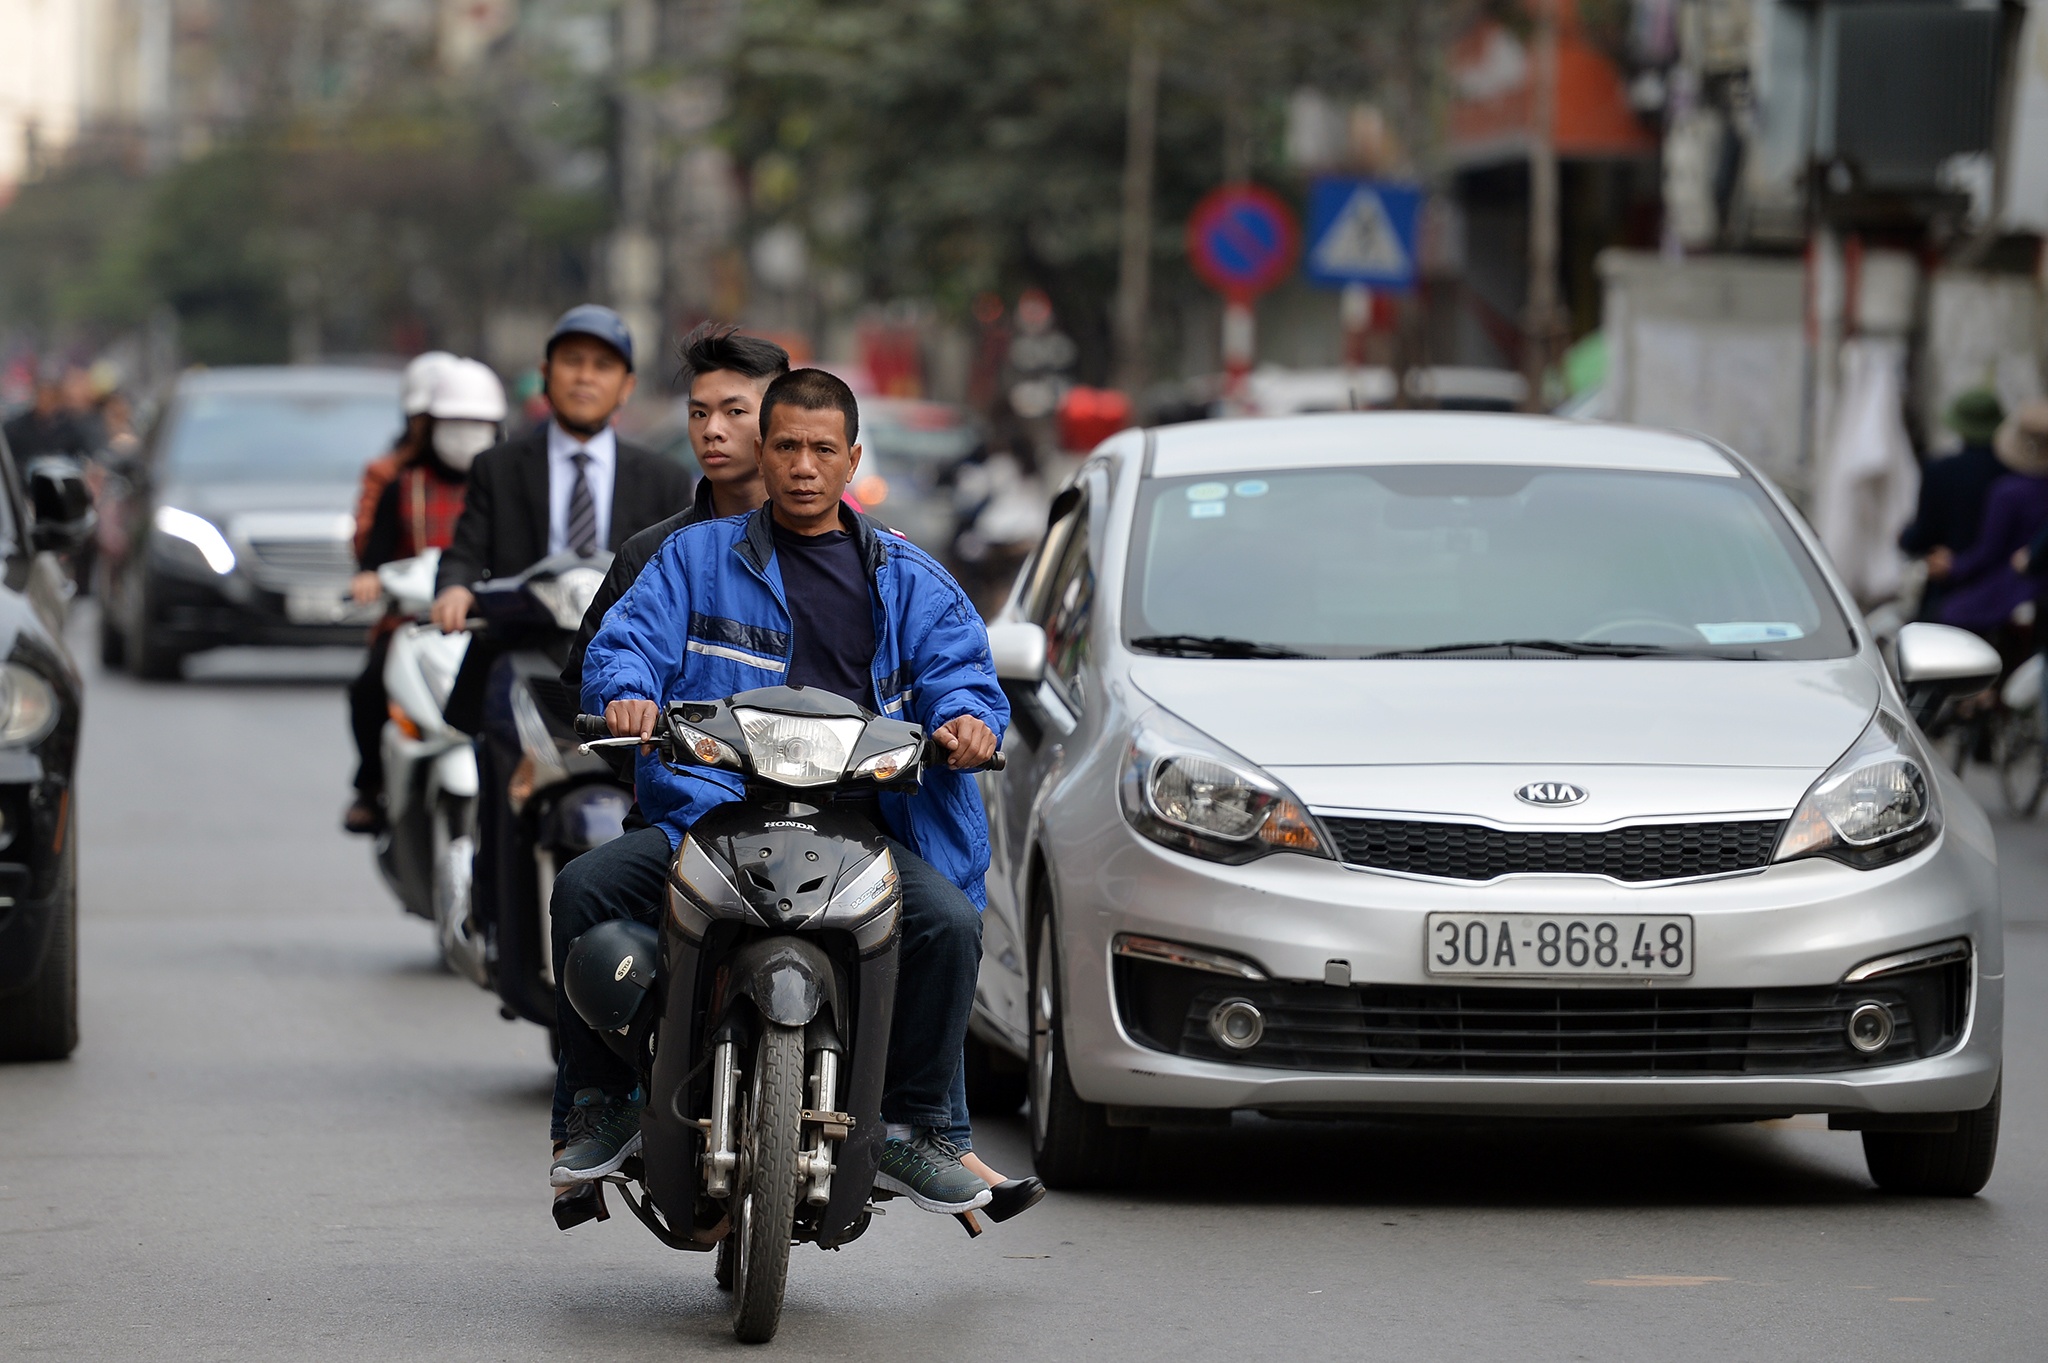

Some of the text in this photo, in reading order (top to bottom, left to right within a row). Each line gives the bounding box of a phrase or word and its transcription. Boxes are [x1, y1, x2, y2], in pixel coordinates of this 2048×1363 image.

[1526, 783, 1578, 801] KIA
[764, 821, 818, 832] HONDA
[1436, 920, 1684, 968] 30A-868.48
